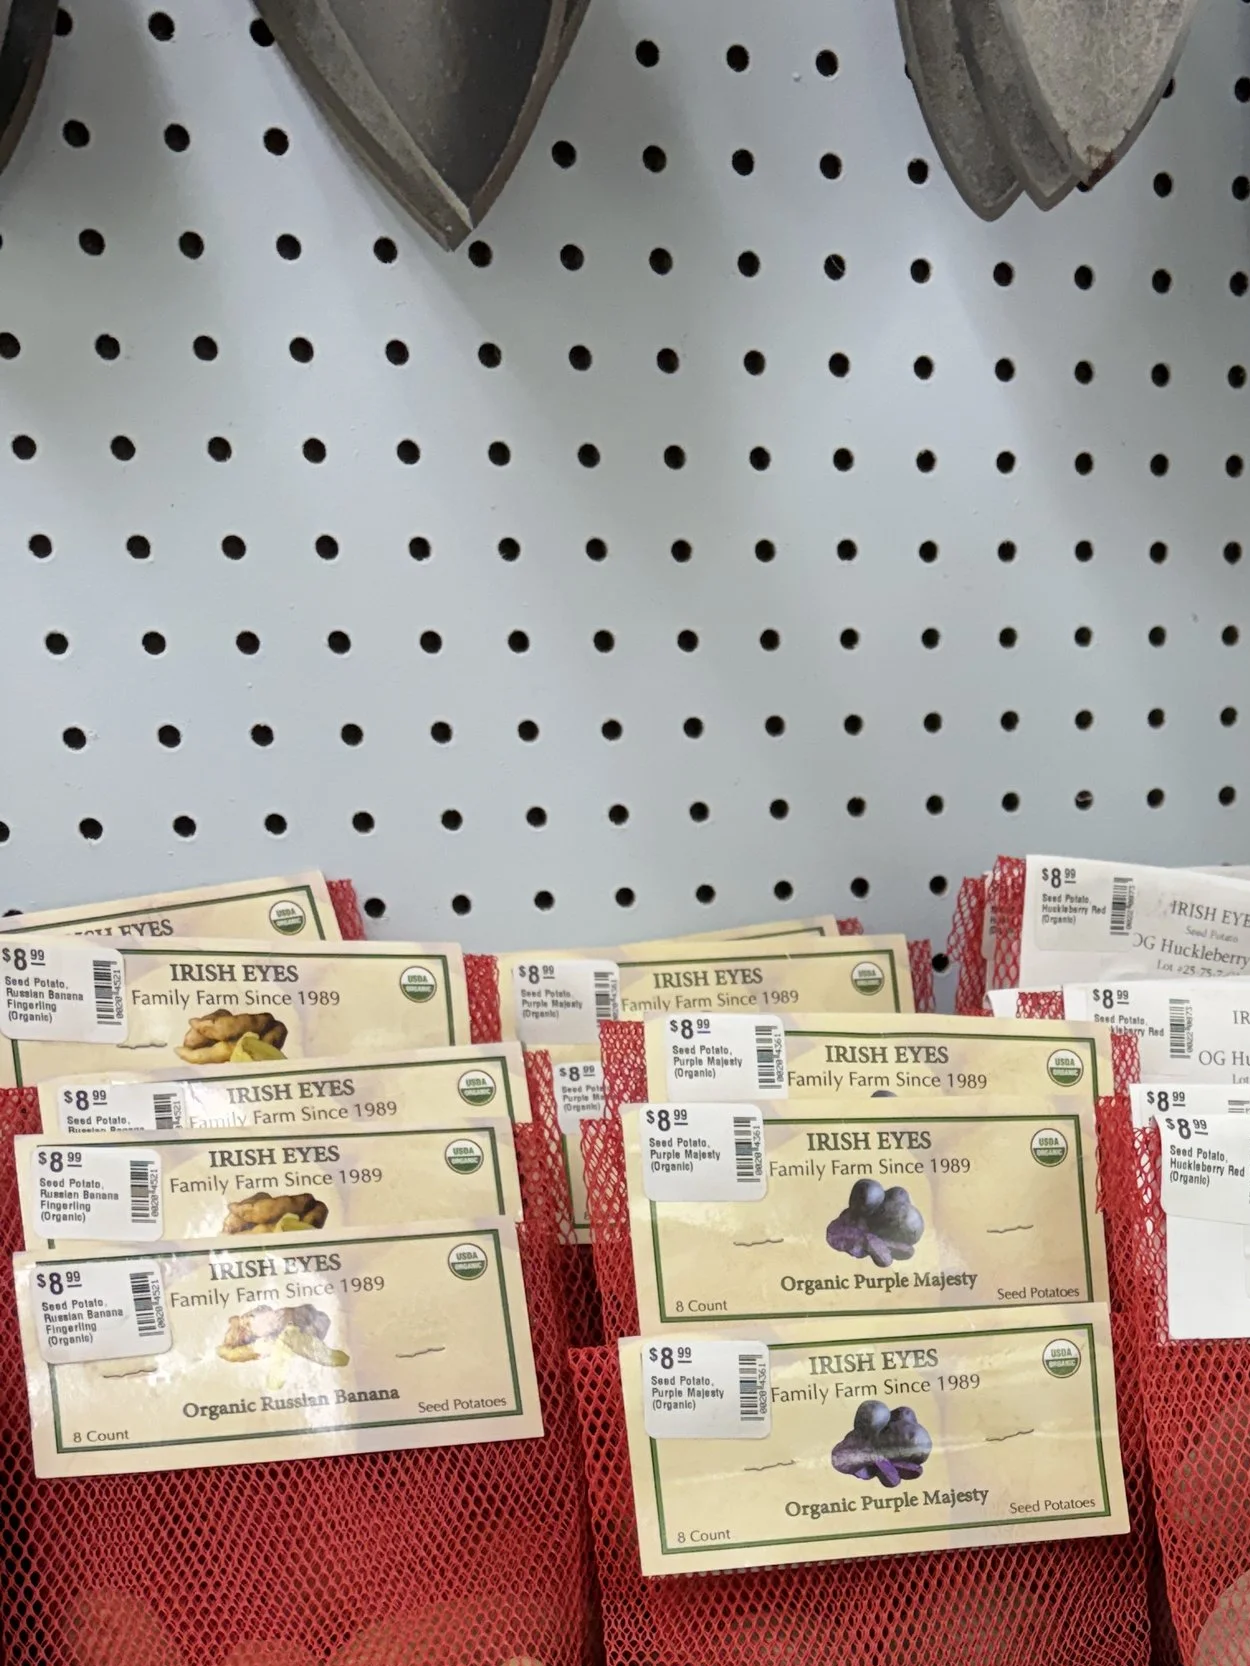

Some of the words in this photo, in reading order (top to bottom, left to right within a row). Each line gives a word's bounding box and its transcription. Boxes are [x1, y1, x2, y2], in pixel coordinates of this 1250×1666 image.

[1172, 900, 1216, 921] IRISH
[1161, 938, 1250, 969] Huckleberry
[5, 976, 30, 986] Seed
[170, 963, 235, 982] IRISH
[244, 964, 299, 982] EYES
[653, 971, 709, 988] IRISH
[715, 969, 763, 985] EYES
[7, 988, 44, 999] Russian
[49, 990, 83, 1000] Banana
[132, 990, 189, 1011] Family
[197, 990, 239, 1006] Farm
[245, 990, 291, 1006] Since
[299, 990, 339, 1006] 1989
[621, 995, 670, 1013] Family
[675, 995, 712, 1008] Farm
[717, 993, 757, 1007] Since
[763, 991, 799, 1005] 1989
[8, 1000, 57, 1012] Fingerling
[9, 1011, 52, 1023] (Organic)
[825, 1045, 887, 1064] IRISH
[895, 1046, 948, 1064] EYES
[1199, 1051, 1225, 1066] OG
[788, 1071, 842, 1089] Family
[849, 1071, 889, 1087] Farm
[896, 1072, 941, 1088] Since
[947, 1073, 988, 1089] 1989
[226, 1081, 292, 1105] IRISH
[299, 1078, 355, 1099] EYES
[254, 1108, 295, 1124] Farm
[301, 1105, 348, 1121] Since
[354, 1101, 397, 1117] 1989
[807, 1132, 870, 1151] IRISH
[878, 1131, 931, 1149] EYES
[209, 1148, 276, 1167] IRISH
[283, 1146, 340, 1163] EYES
[453, 1146, 474, 1156] USDA
[1170, 1145, 1192, 1157] Seed
[769, 1159, 826, 1180] Family
[832, 1159, 872, 1175] Farm
[879, 1158, 924, 1174] Since
[931, 1158, 970, 1173] 1989
[1170, 1158, 1224, 1176] Huckleberry
[1228, 1166, 1245, 1177] Red
[170, 1177, 229, 1195] Family
[236, 1174, 278, 1190] Farm
[285, 1172, 332, 1187] Since
[340, 1168, 382, 1183] 1989
[1170, 1171, 1210, 1186] (Organic)
[456, 1252, 478, 1261] USDA
[209, 1259, 276, 1281] IRISH
[284, 1254, 341, 1274] EYES
[170, 1288, 229, 1308] Family
[237, 1286, 279, 1303] Farm
[286, 1282, 334, 1298] Since
[341, 1276, 385, 1293] 1989
[781, 1274, 849, 1295] Organic
[854, 1274, 909, 1292] Purple
[914, 1271, 977, 1291] Majesty
[997, 1288, 1026, 1300] Seed
[1029, 1286, 1079, 1299] Potatoes
[42, 1301, 67, 1311] Seed
[676, 1301, 684, 1312] 8
[688, 1300, 728, 1312] Count
[44, 1312, 83, 1323] Russian
[88, 1308, 123, 1319] Banana
[46, 1322, 96, 1334] Fingerling
[48, 1333, 93, 1347] (Organic)
[1051, 1348, 1072, 1357] USDA
[808, 1351, 875, 1375] IRISH
[881, 1349, 938, 1370] EYES
[771, 1383, 829, 1404] Family
[835, 1381, 878, 1398] Farm
[883, 1378, 930, 1394] Since
[938, 1374, 980, 1390] 1989
[183, 1401, 257, 1421] Organic
[261, 1393, 328, 1411] Russian
[334, 1386, 400, 1403] Banana
[418, 1399, 449, 1413] Seed
[454, 1396, 507, 1411] Potatoes
[74, 1432, 81, 1442] 8
[87, 1429, 129, 1442] Count
[785, 1499, 857, 1519] Organic
[861, 1494, 918, 1513] Purple
[923, 1488, 988, 1508] Majesty
[1010, 1502, 1040, 1514] Seed
[1044, 1498, 1096, 1511] Potatoes
[678, 1532, 686, 1543] 8
[690, 1529, 730, 1542] Count
